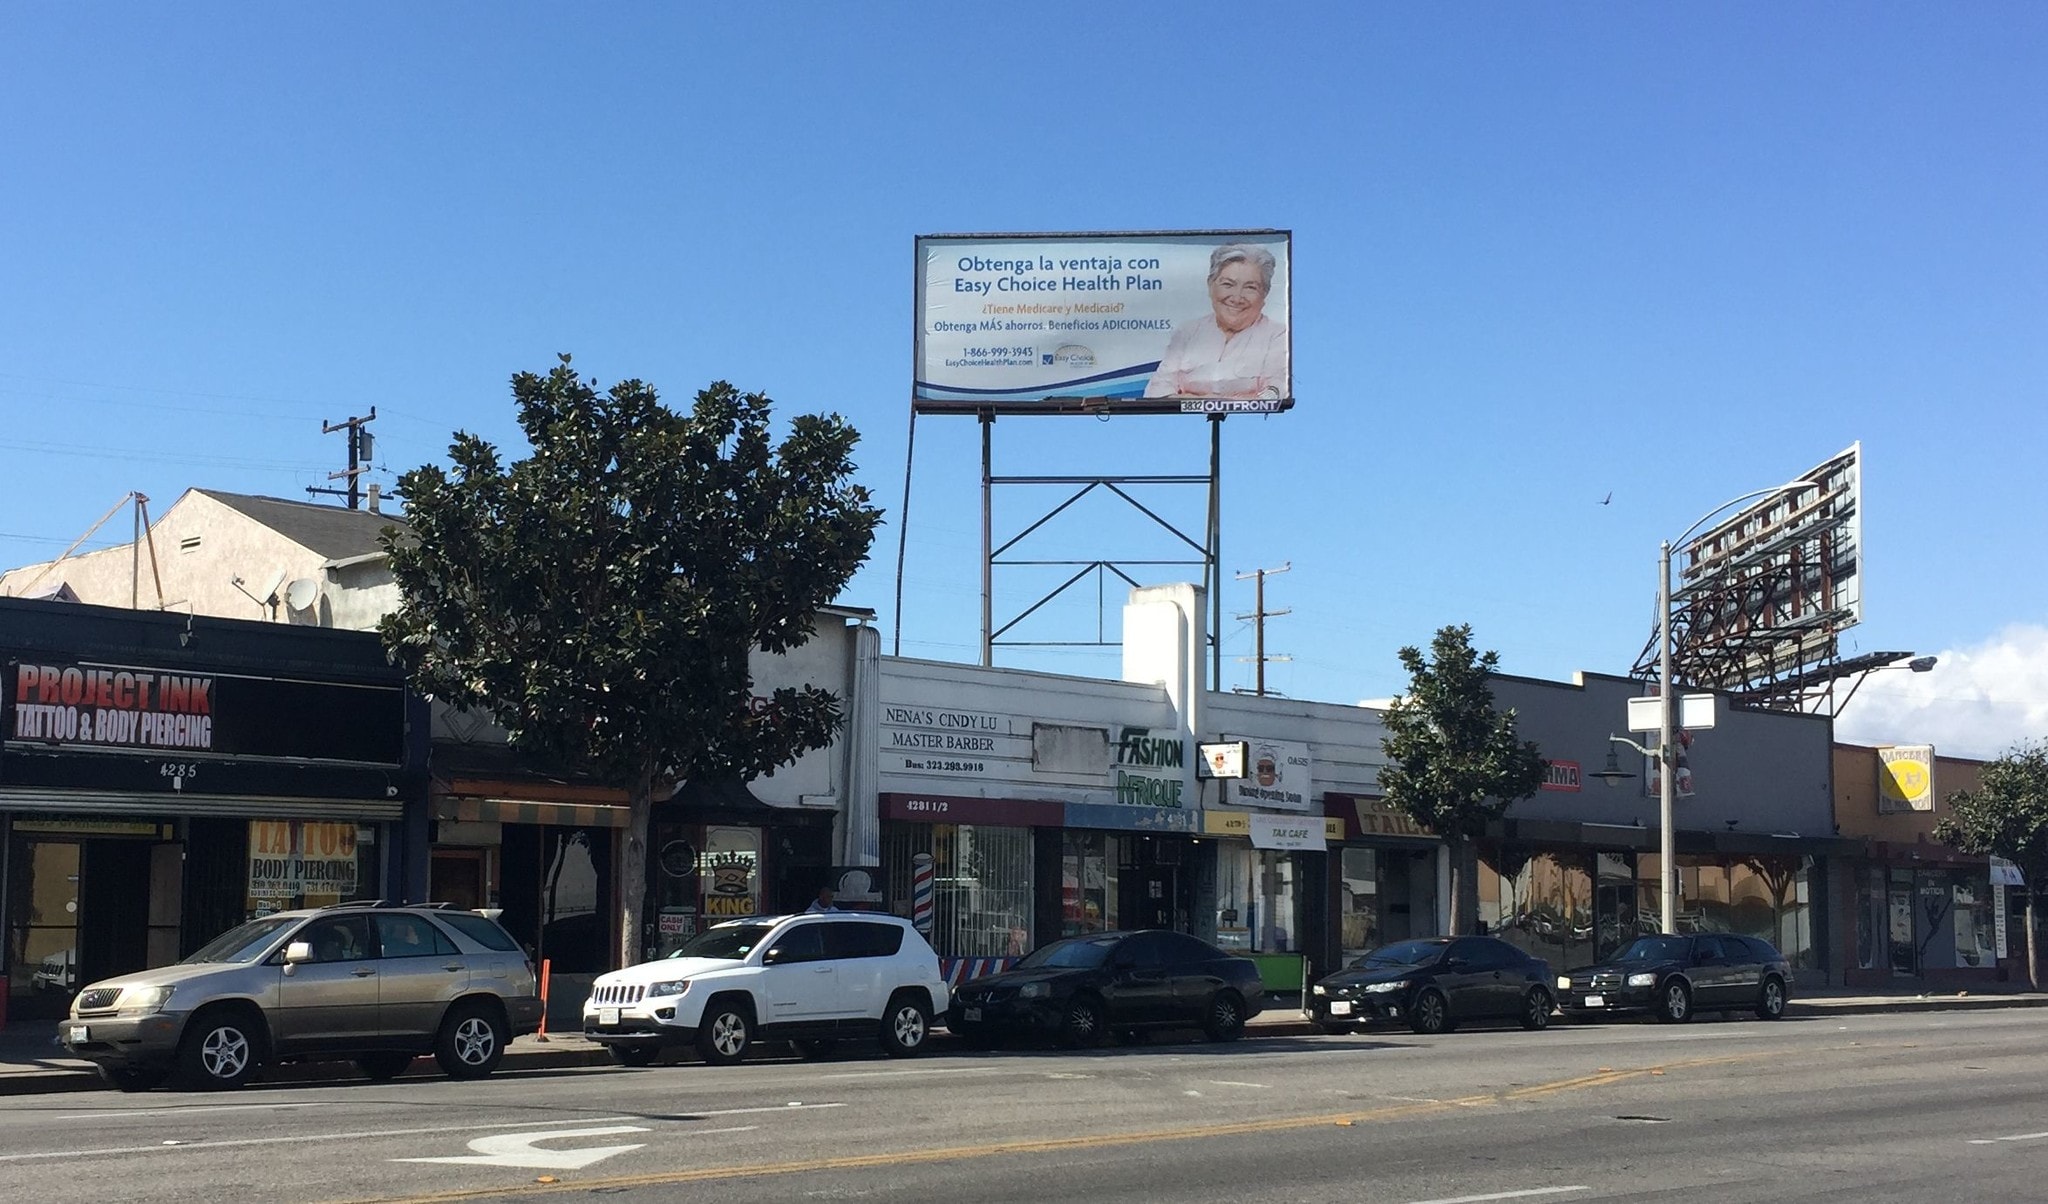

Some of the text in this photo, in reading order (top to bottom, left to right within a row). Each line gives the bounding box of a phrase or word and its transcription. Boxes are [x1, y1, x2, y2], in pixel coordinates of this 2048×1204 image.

[958, 255, 1160, 275] Obtenga la ventaja con
[955, 274, 1162, 296] Easy Choice Health Plan
[982, 302, 1125, 315] ¿Tiene Medicare y Medicaid?
[934, 320, 977, 333] Obtenga
[980, 317, 1002, 331] MÁS
[1005, 319, 1047, 331] ahorros.
[1048, 319, 1099, 330] Beneficios
[963, 347, 1033, 357] 1-866-999-3945
[945, 358, 1033, 368] EasyChoiceHealthPlan.com
[1204, 400, 1278, 411] OUTFRONT
[17, 664, 212, 713] PROJECT INK
[16, 703, 211, 748] TATTOO & BODY PIERCING
[886, 708, 997, 730] NENA'S CINDY LU
[893, 732, 994, 751] MASTER BARBER
[1118, 728, 1184, 768] FASHION
[160, 763, 197, 778] 4285
[932, 801, 948, 812] 1/2
[258, 820, 355, 857] TATTOO
[1272, 828, 1309, 838] TAX CAFE
[252, 859, 355, 881] BODY PIERCING
[708, 897, 754, 914] KING
[661, 924, 681, 932] ONLY
